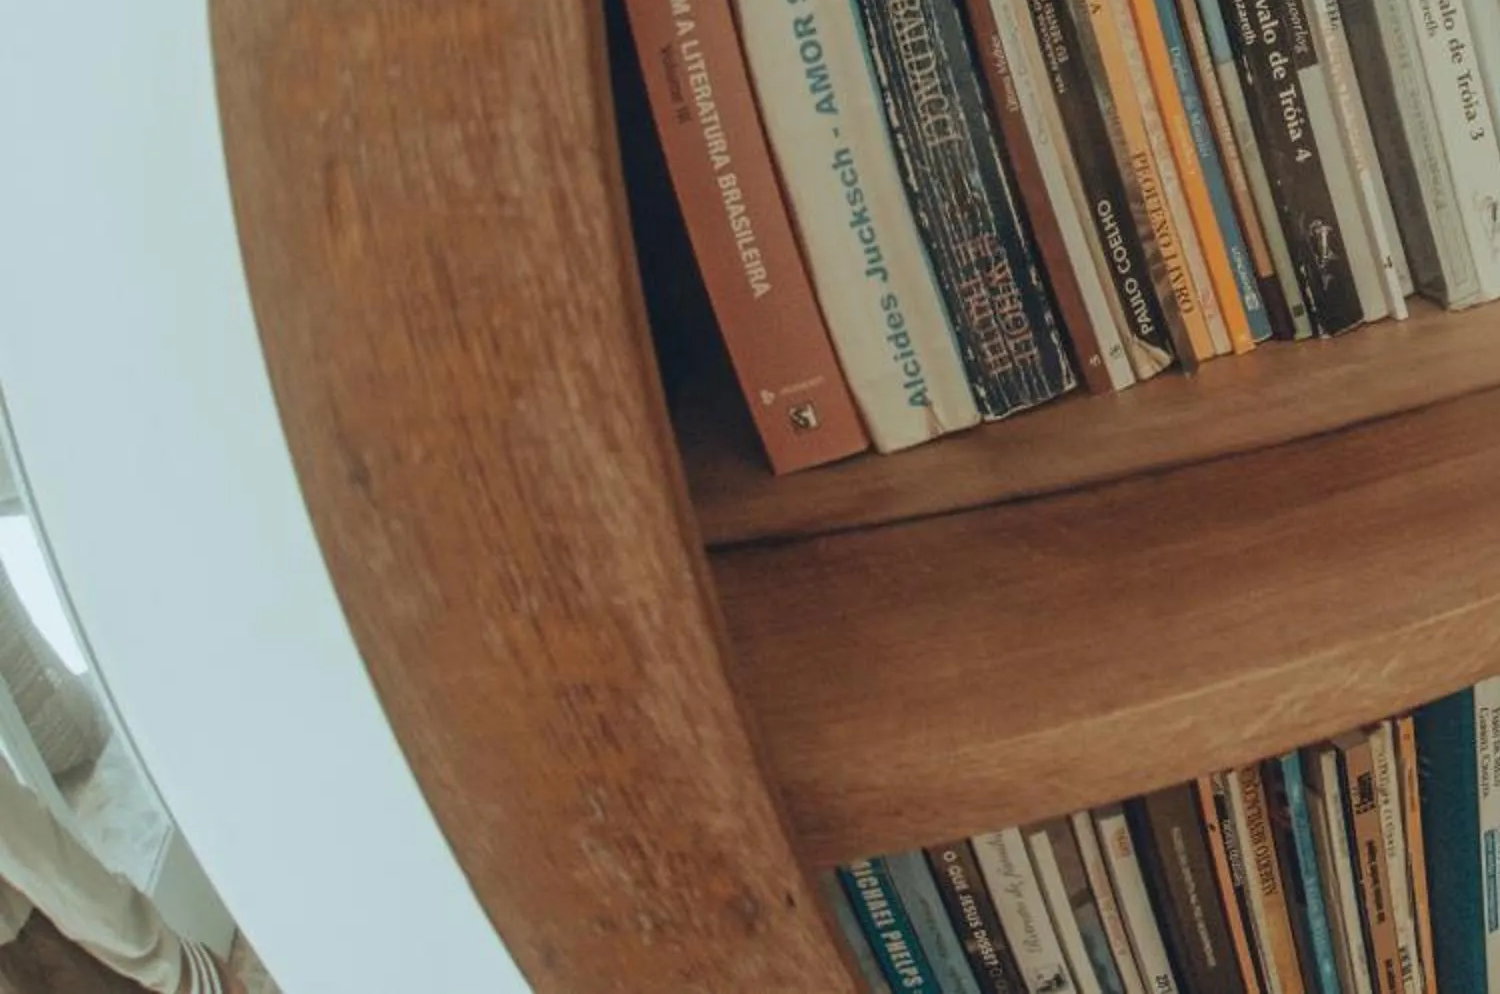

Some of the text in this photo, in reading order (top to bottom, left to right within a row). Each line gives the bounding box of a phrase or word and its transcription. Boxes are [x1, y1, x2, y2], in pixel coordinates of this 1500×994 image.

[676, 18, 696, 36] A
[1448, 38, 1465, 65] de
[660, 46, 685, 104] Volume
[793, 14, 839, 114] AMOR
[680, 39, 730, 170] LITERATURA
[1268, 51, 1288, 79] de
[1278, 85, 1302, 142] Tróia
[1295, 146, 1313, 162] 4
[1456, 70, 1477, 123] Tróia
[1470, 128, 1484, 142] 3
[831, 148, 888, 283] Jucksch
[1133, 152, 1173, 250] PEQUENO
[718, 174, 773, 299] BRASILEIRA
[1096, 198, 1153, 334] PAULO COELHO
[880, 295, 932, 409] Alcides
[943, 851, 956, 863] O
[948, 865, 969, 891] QUE
[959, 894, 983, 928] JESUS
[880, 930, 924, 988] PHELPS
